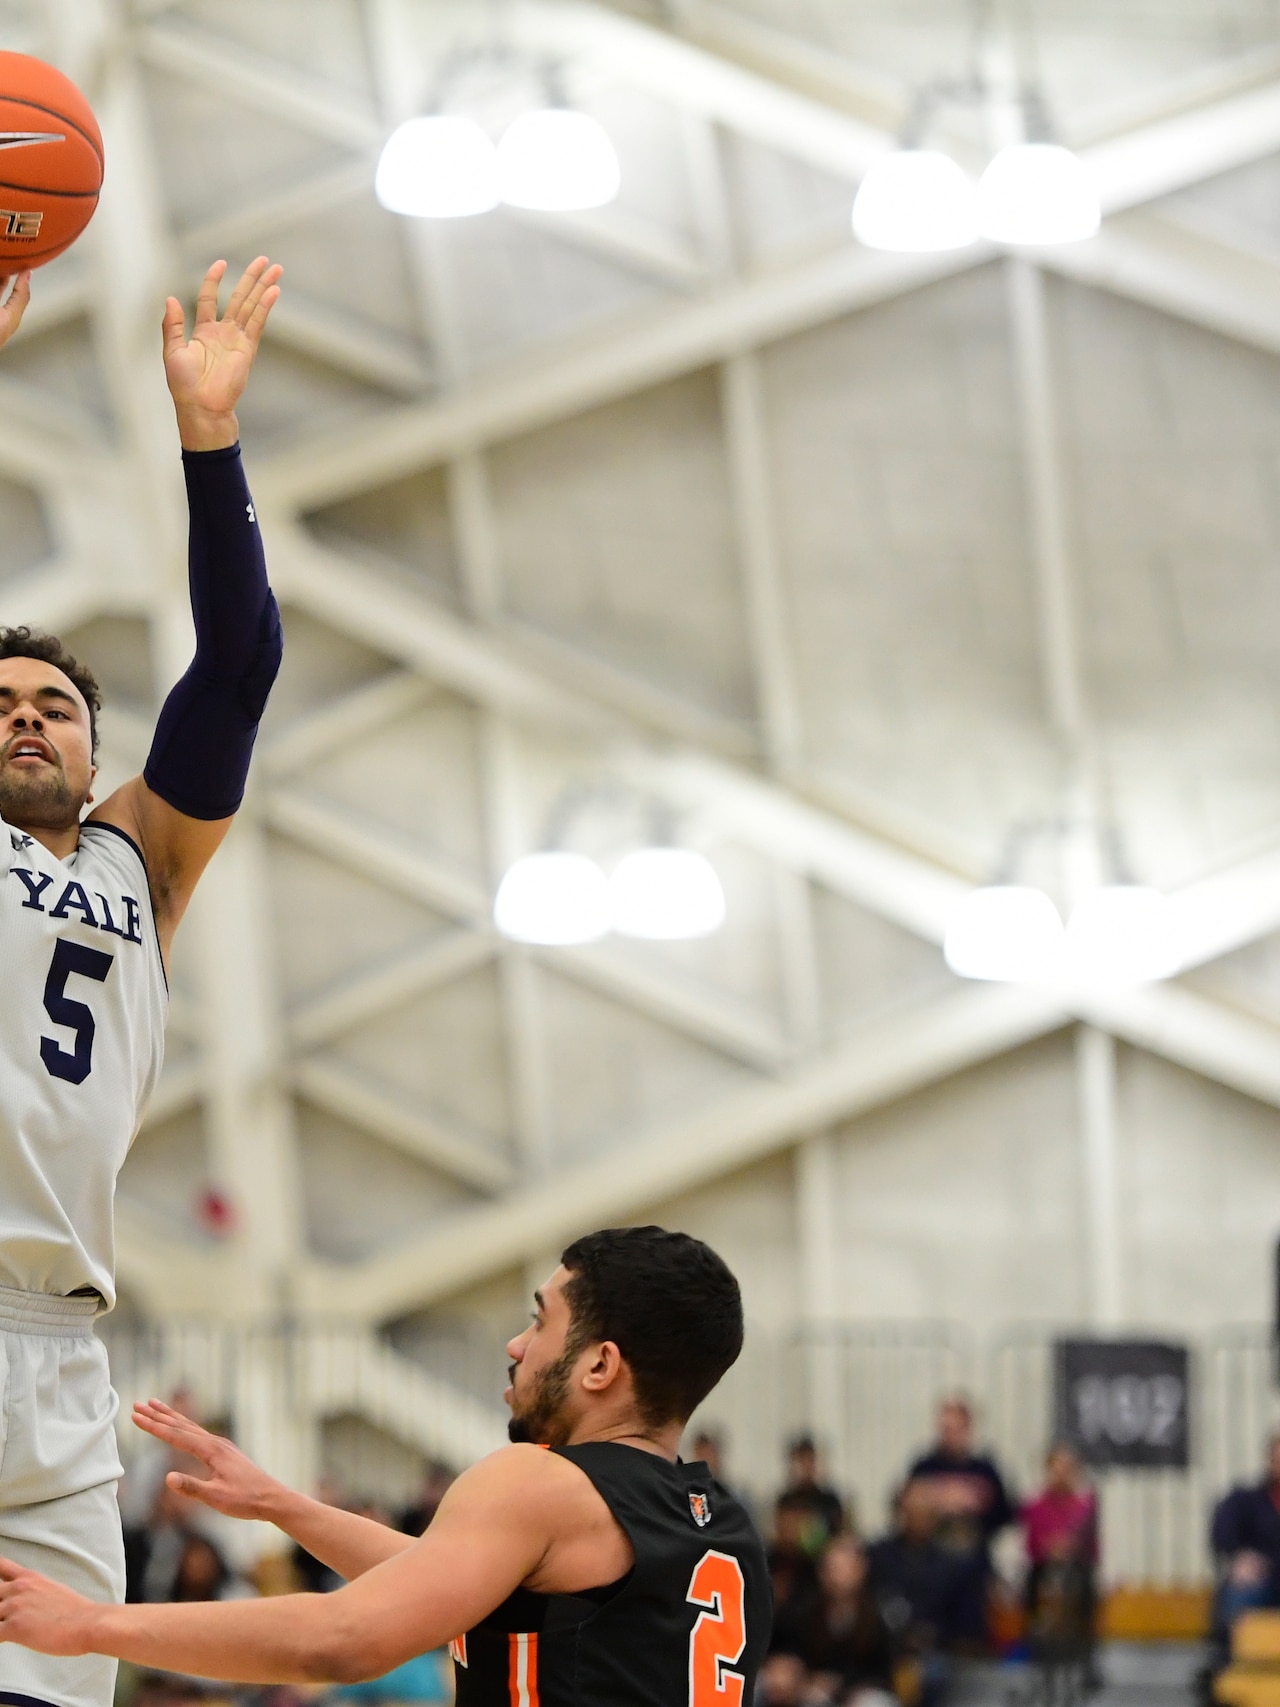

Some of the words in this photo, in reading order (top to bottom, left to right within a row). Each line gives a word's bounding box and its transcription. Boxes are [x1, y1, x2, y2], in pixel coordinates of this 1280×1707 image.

[9, 867, 143, 947] YALE
[39, 937, 115, 1086] 5
[685, 1549, 747, 1707] 2
